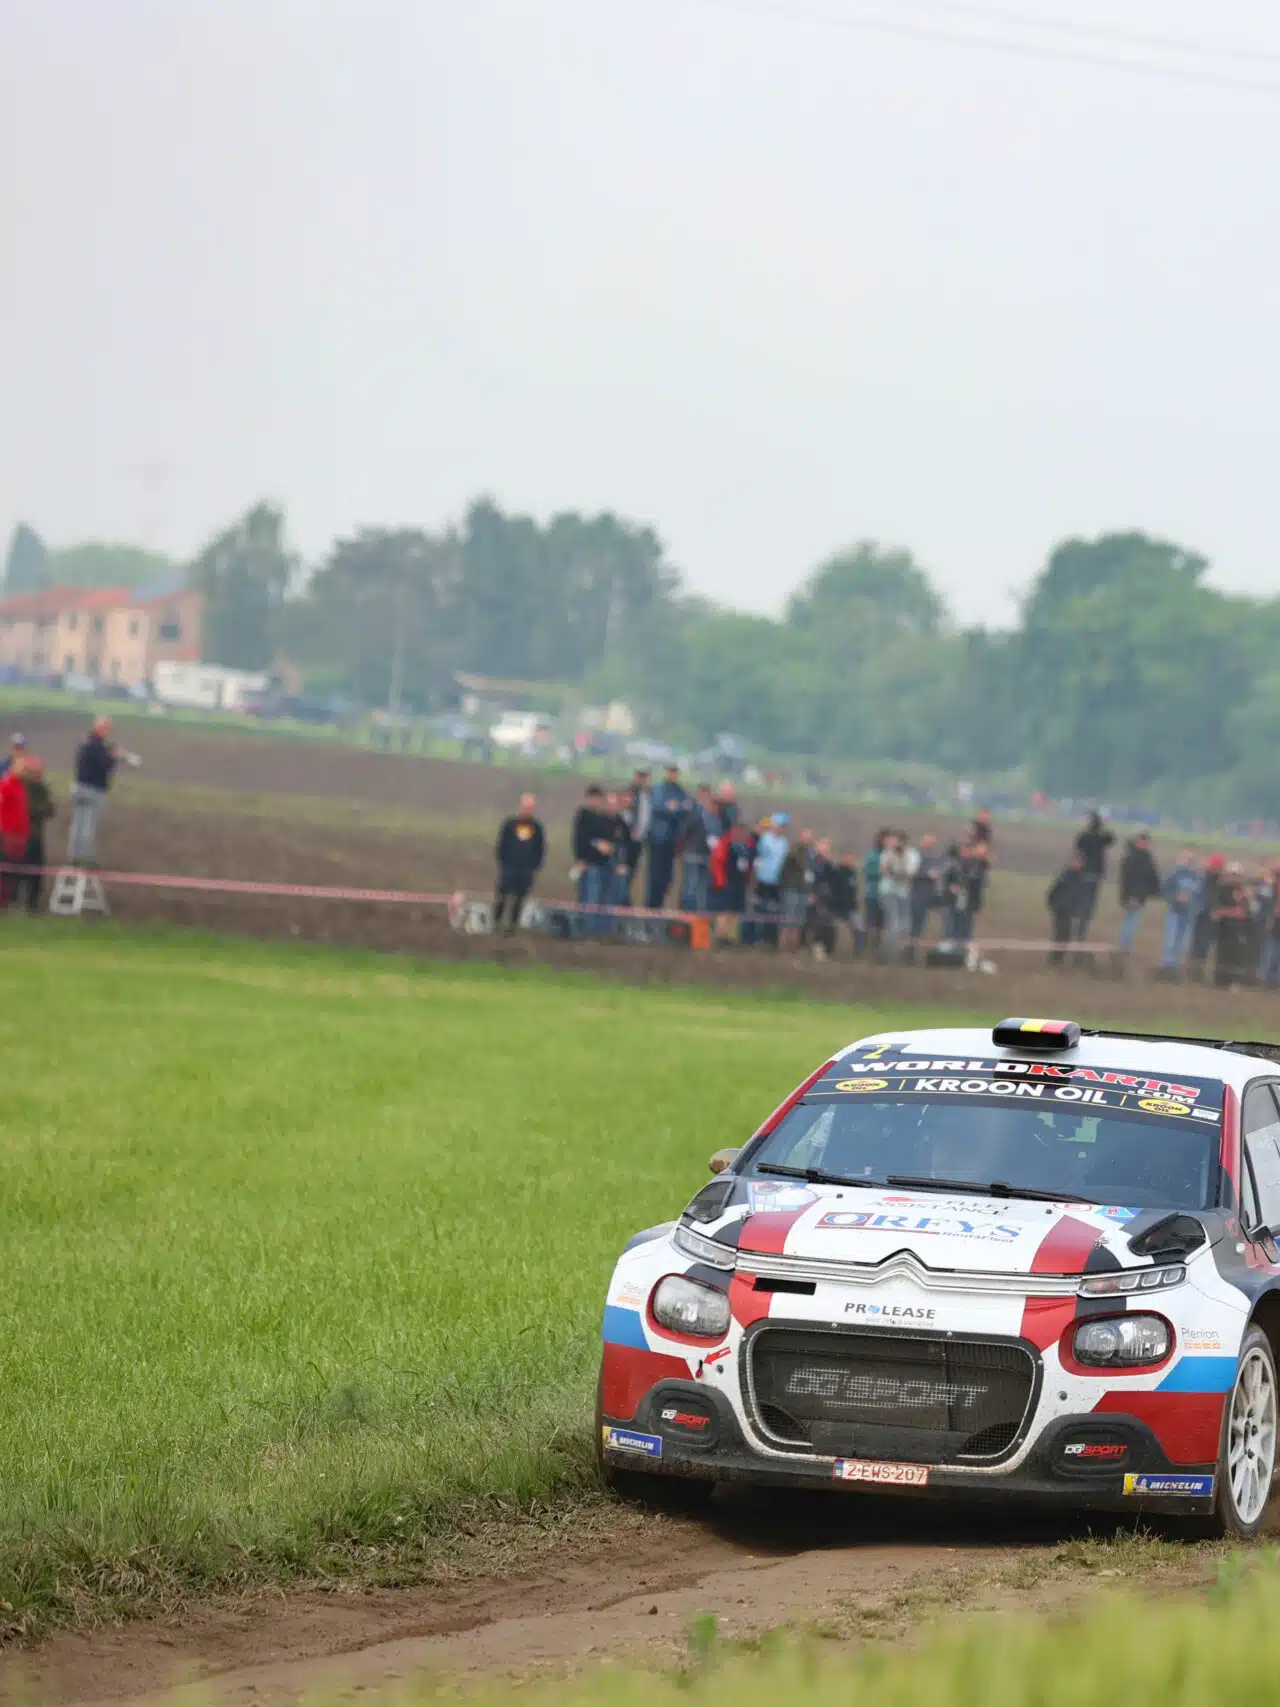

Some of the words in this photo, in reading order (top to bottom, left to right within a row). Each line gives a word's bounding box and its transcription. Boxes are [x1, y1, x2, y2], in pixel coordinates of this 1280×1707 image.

[862, 1044, 891, 1060] 2
[851, 1060, 1200, 1098] WORLDKARTS
[914, 1079, 1044, 1097] KROON
[1054, 1086, 1108, 1105] OIL
[1150, 1481, 1204, 1490] MICHELIN
